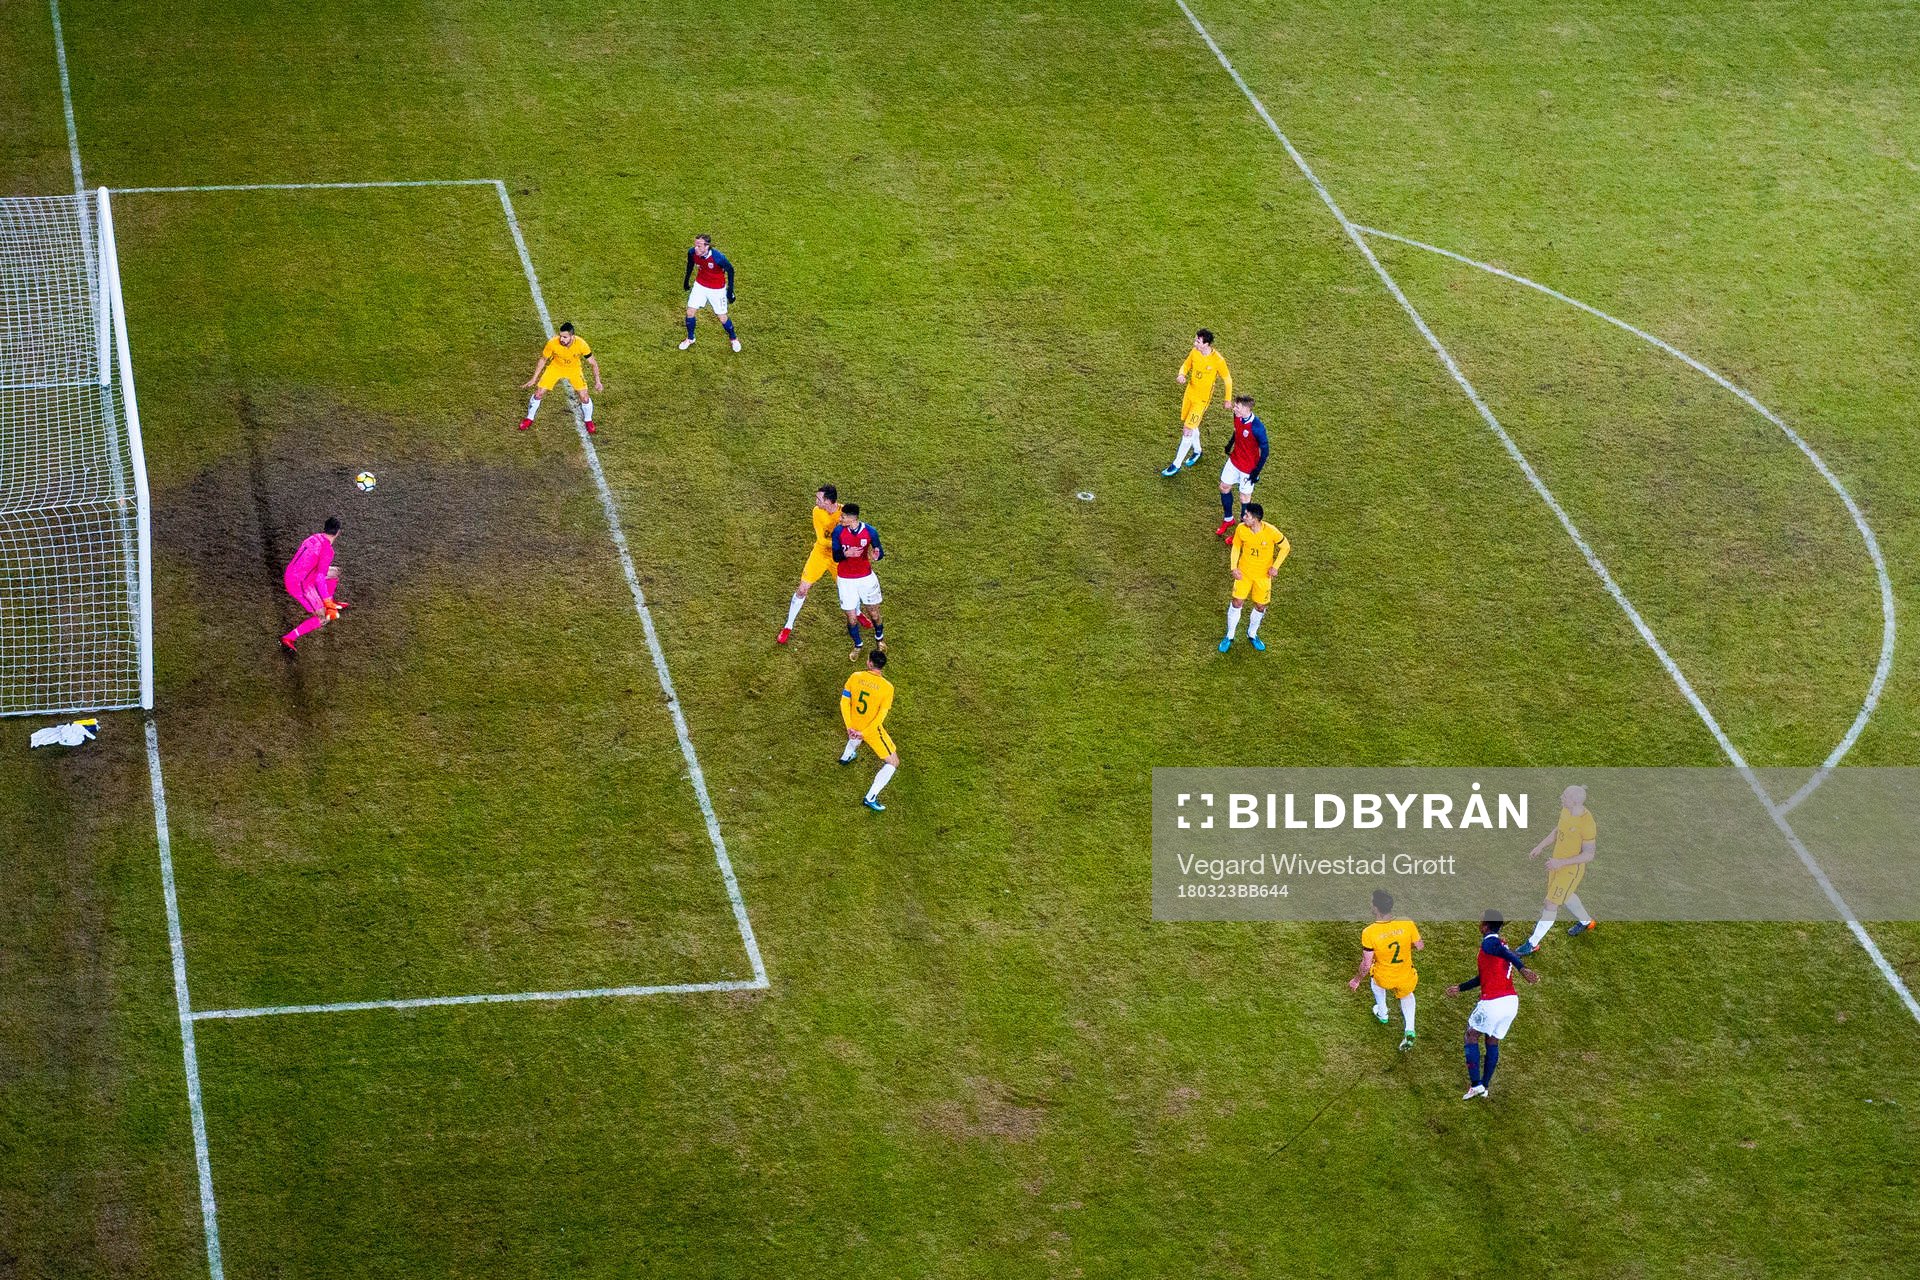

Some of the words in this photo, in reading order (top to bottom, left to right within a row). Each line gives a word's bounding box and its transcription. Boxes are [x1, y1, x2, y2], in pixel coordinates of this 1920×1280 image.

[1250, 548, 1259, 558] 21
[856, 690, 870, 715] 5
[1553, 886, 1564, 898] 13
[1388, 942, 1403, 963] 2
